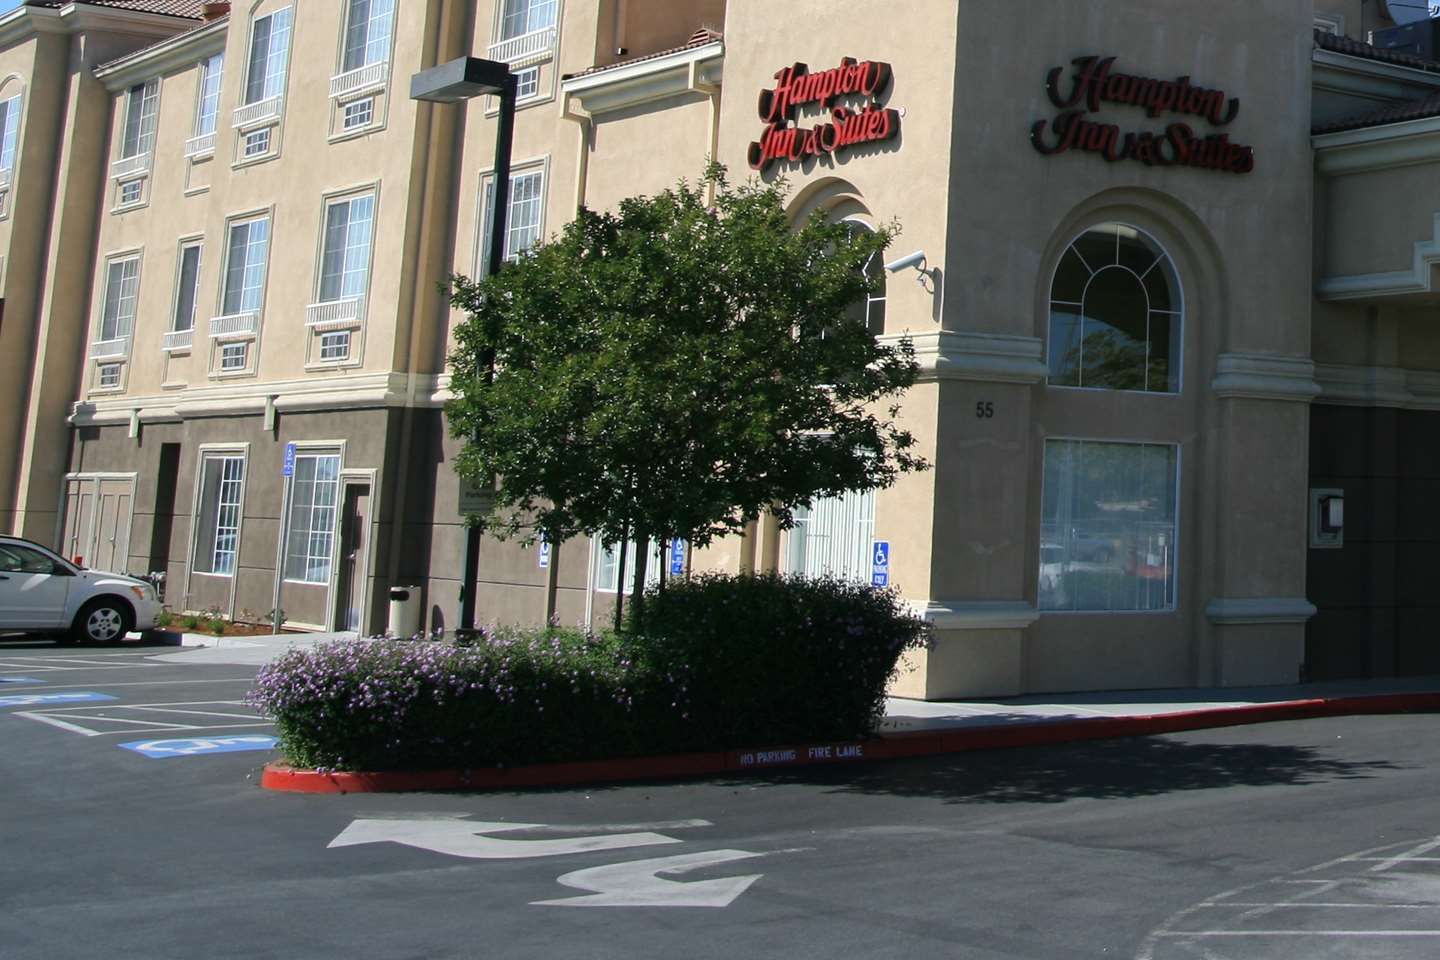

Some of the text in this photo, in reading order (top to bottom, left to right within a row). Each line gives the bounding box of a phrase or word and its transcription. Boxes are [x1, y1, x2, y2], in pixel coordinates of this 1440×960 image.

[758, 58, 890, 123] Hampton
[1046, 56, 1239, 125] Hampton
[748, 122, 806, 170] Inn
[821, 106, 897, 152] Suites
[1031, 109, 1135, 160] Inn
[1153, 123, 1253, 173] Suites
[976, 401, 994, 418] 55
[757, 750, 796, 764] PARKING
[808, 746, 831, 759] FIRE
[836, 745, 863, 757] LANE
